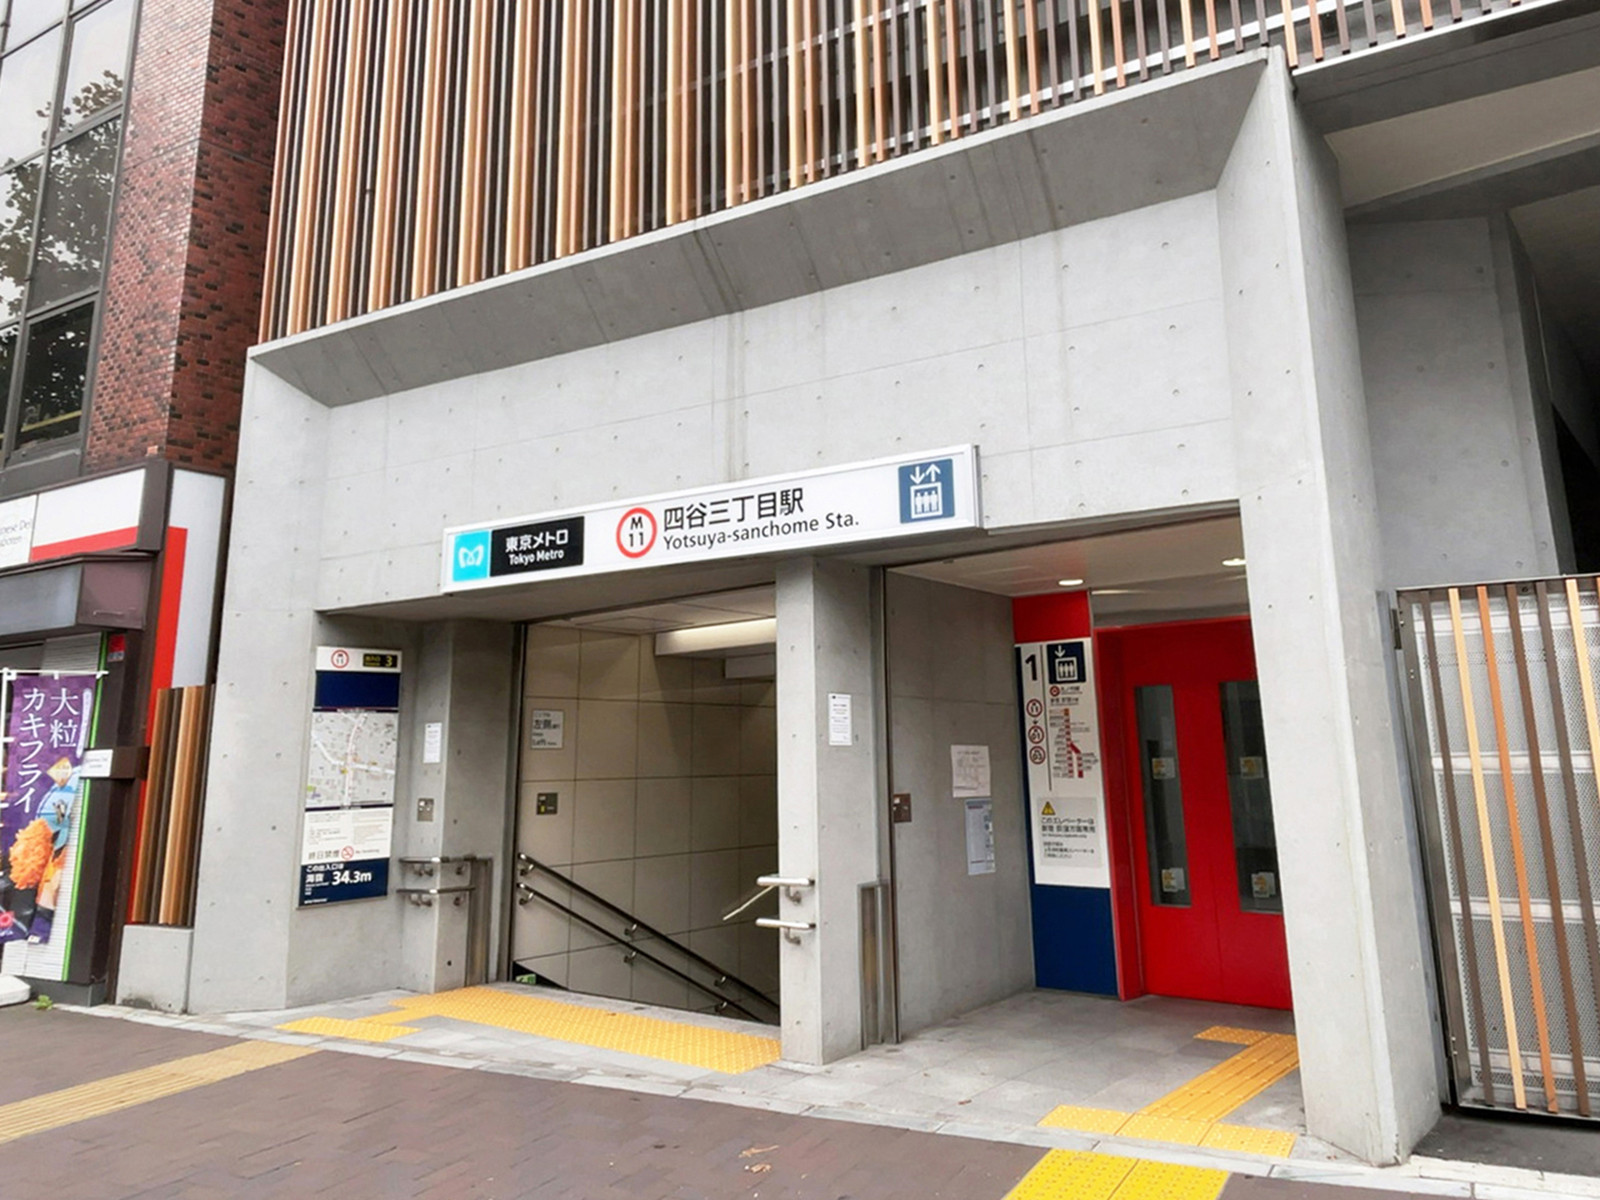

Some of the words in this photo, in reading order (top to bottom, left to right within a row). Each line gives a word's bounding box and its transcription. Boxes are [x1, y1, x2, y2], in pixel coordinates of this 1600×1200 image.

[664, 488, 804, 532] 四谷三丁目駅
[631, 516, 643, 530] M
[663, 519, 819, 550] Yotsuya-sanchome
[825, 512, 859, 529] Sta.
[505, 529, 569, 552] 東京メトロ
[629, 532, 644, 547] 11
[509, 551, 535, 566] Tokyo
[536, 548, 564, 562] Metro
[385, 655, 394, 667] 3
[1025, 654, 1038, 681] 1
[50, 687, 80, 748] 大粒
[14, 688, 46, 814] カキフライ
[331, 870, 372, 886] 34.3m
